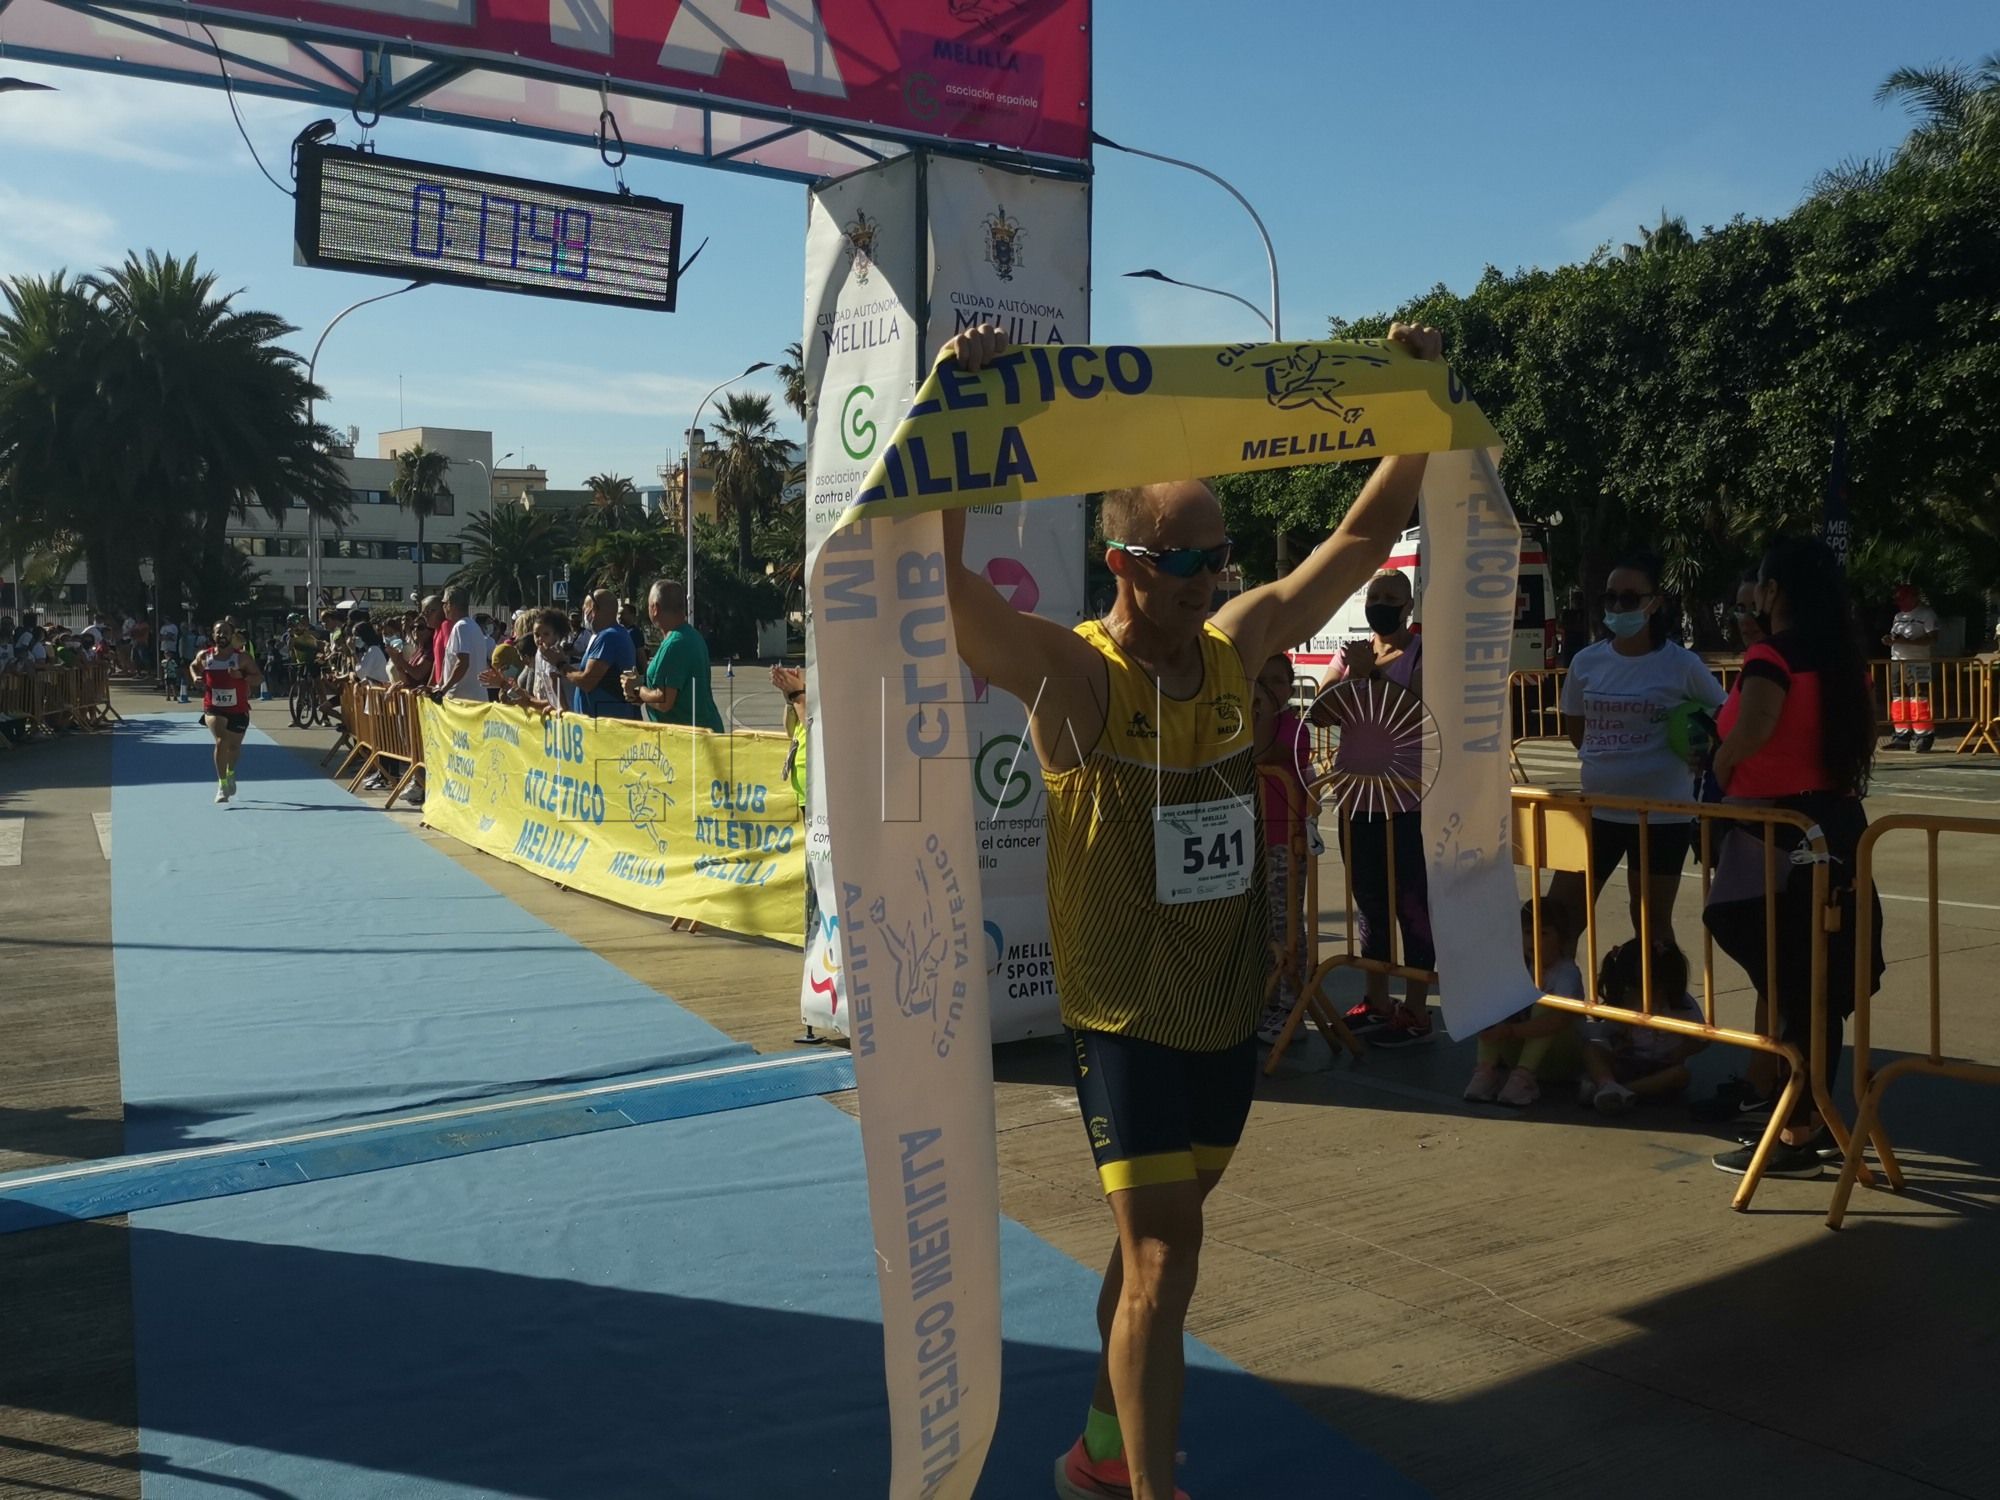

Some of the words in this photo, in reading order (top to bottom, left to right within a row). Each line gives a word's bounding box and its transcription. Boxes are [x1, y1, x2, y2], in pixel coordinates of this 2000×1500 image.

[932, 38, 1021, 73] MELILLA
[816, 308, 851, 326] CIUDAD
[949, 291, 994, 309] CIUDAD
[998, 299, 1065, 320] AUTÓNOMA
[821, 315, 900, 357] MELILLA
[1241, 428, 1377, 461] MELILLA
[815, 467, 860, 487] asociación
[814, 490, 843, 505] contra
[845, 487, 853, 501] el
[815, 512, 827, 523] en
[216, 694, 233, 703] 467
[1593, 700, 1667, 714] marcha
[544, 719, 584, 765] CLUB
[618, 745, 640, 775] CLUB
[523, 765, 606, 826] ATLÉTICO
[710, 779, 768, 814] CLUB
[512, 818, 590, 874] MELILLA
[695, 808, 795, 855] ATLÉTICO
[981, 835, 993, 850] el
[996, 834, 1041, 849] cáncer
[1183, 828, 1244, 875] 541
[607, 851, 666, 888] MELILLA
[694, 853, 778, 888] MELILLA
[1008, 980, 1059, 999] CAPIT
